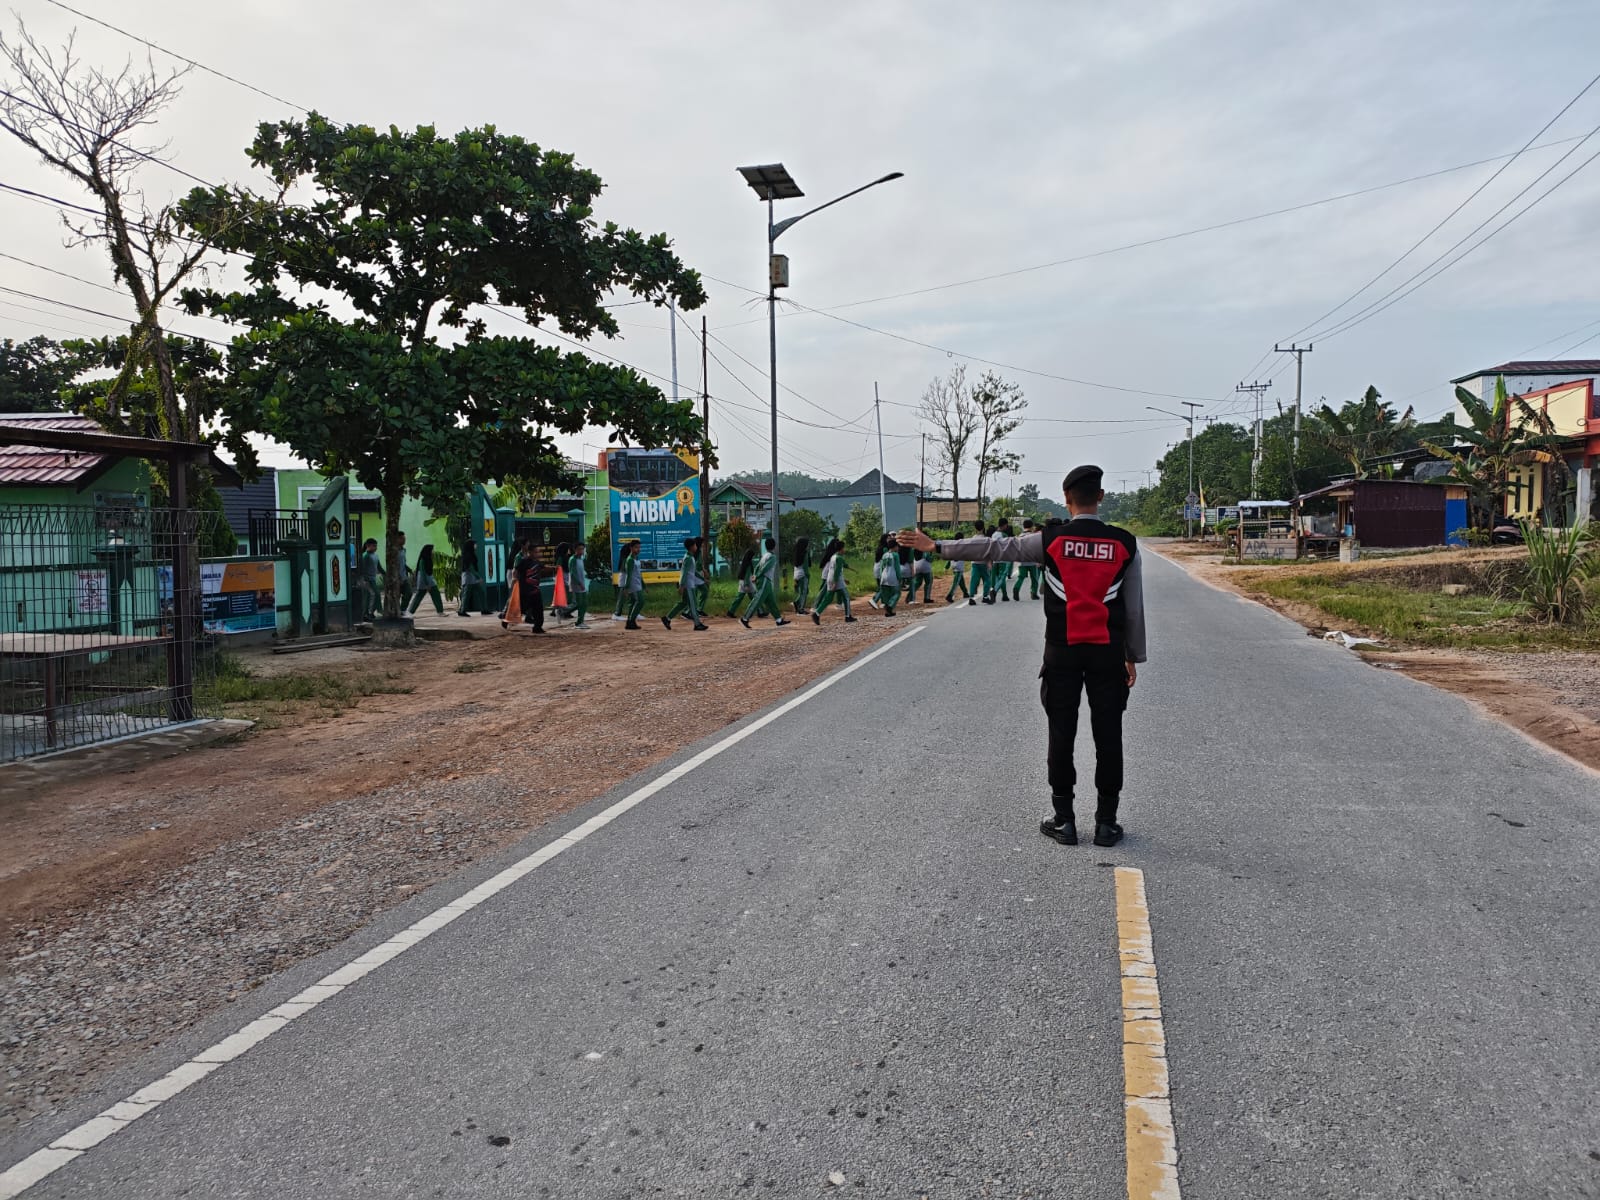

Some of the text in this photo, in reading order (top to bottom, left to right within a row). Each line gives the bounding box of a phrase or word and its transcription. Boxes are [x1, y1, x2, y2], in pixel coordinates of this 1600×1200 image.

[619, 500, 676, 523] PMBM
[1064, 541, 1114, 560] POLISI
[1245, 541, 1268, 554] ADA
